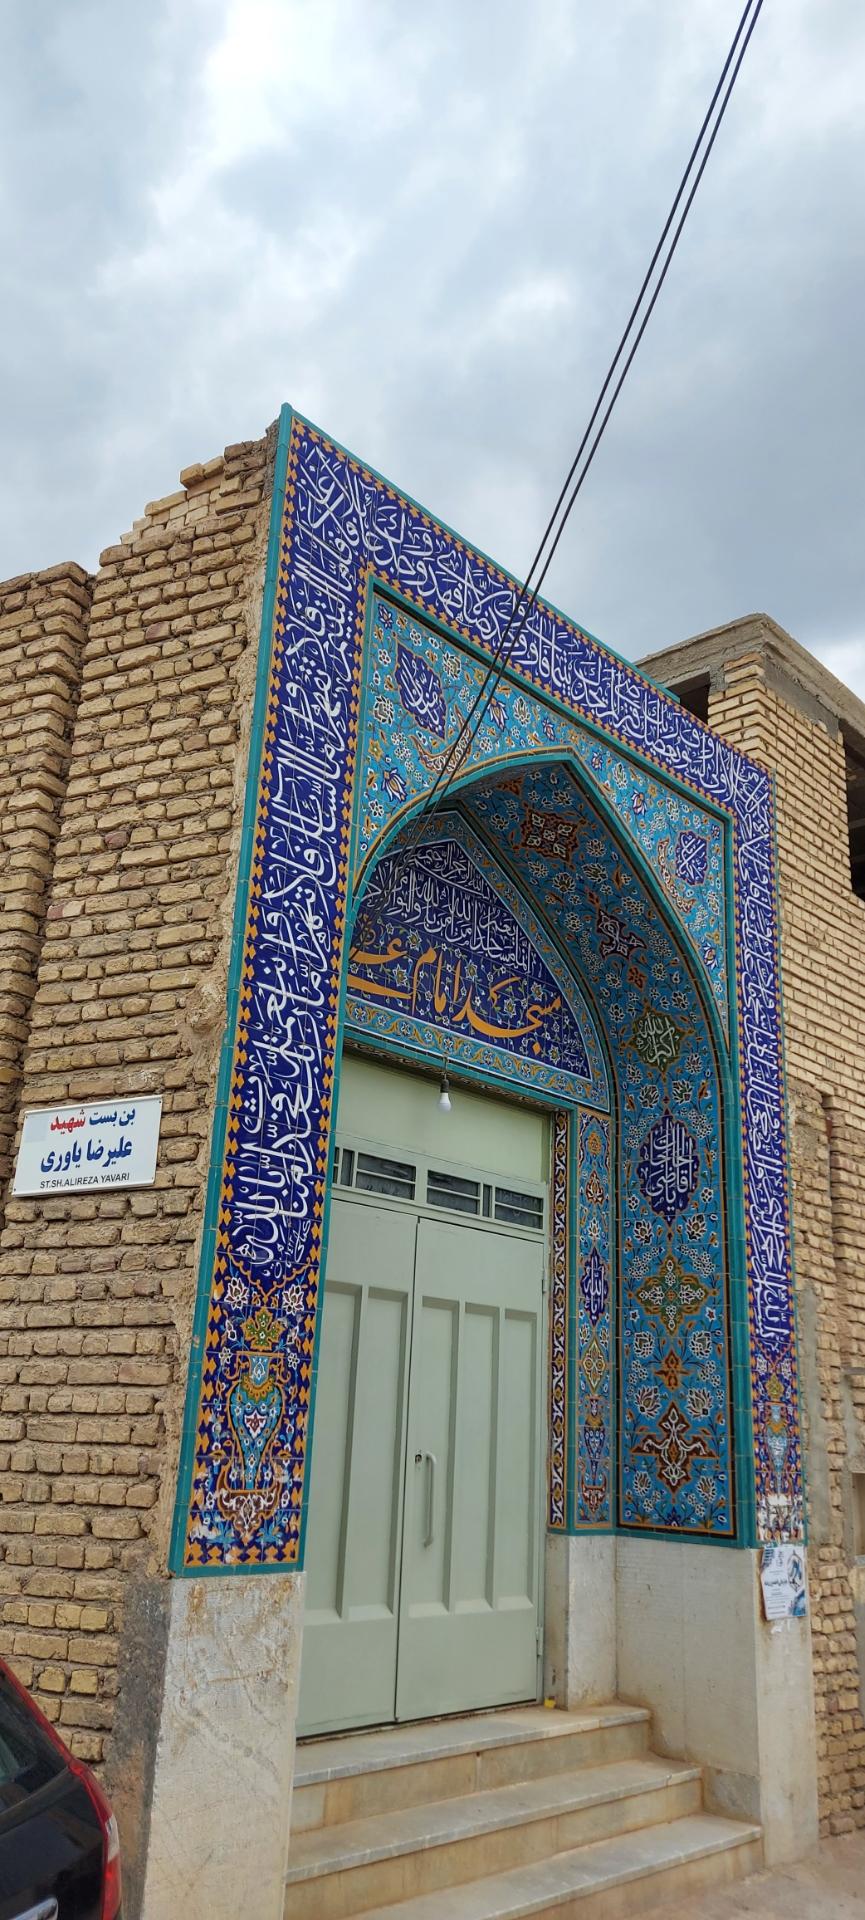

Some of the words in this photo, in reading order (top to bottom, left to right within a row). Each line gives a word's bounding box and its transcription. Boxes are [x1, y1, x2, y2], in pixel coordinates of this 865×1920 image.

[411, 945, 462, 1016] امام
[50, 1109, 86, 1134] شهید
[89, 1109, 118, 1127] بست
[118, 1107, 136, 1127] بن
[40, 1140, 82, 1172] یاوری
[86, 1136, 133, 1167] علیرضا
[40, 1175, 98, 1189] ST.SH.ALIREZA
[101, 1173, 130, 1183] YAVARI
